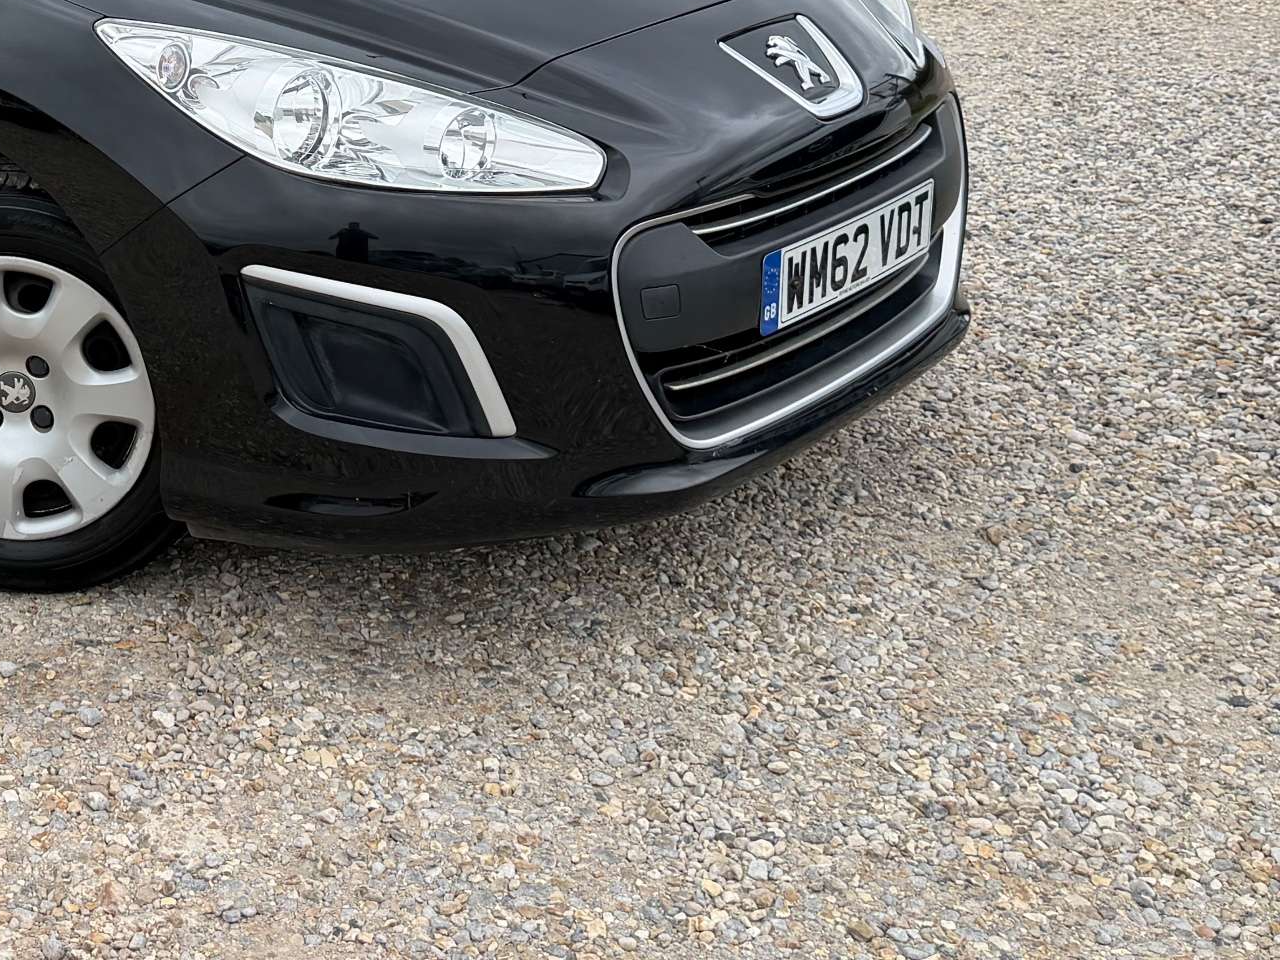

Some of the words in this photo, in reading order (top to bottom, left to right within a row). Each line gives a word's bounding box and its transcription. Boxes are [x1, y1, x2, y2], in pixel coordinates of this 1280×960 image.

[786, 222, 870, 315] WM62
[879, 191, 930, 267] VDT
[764, 302, 777, 321] GB
